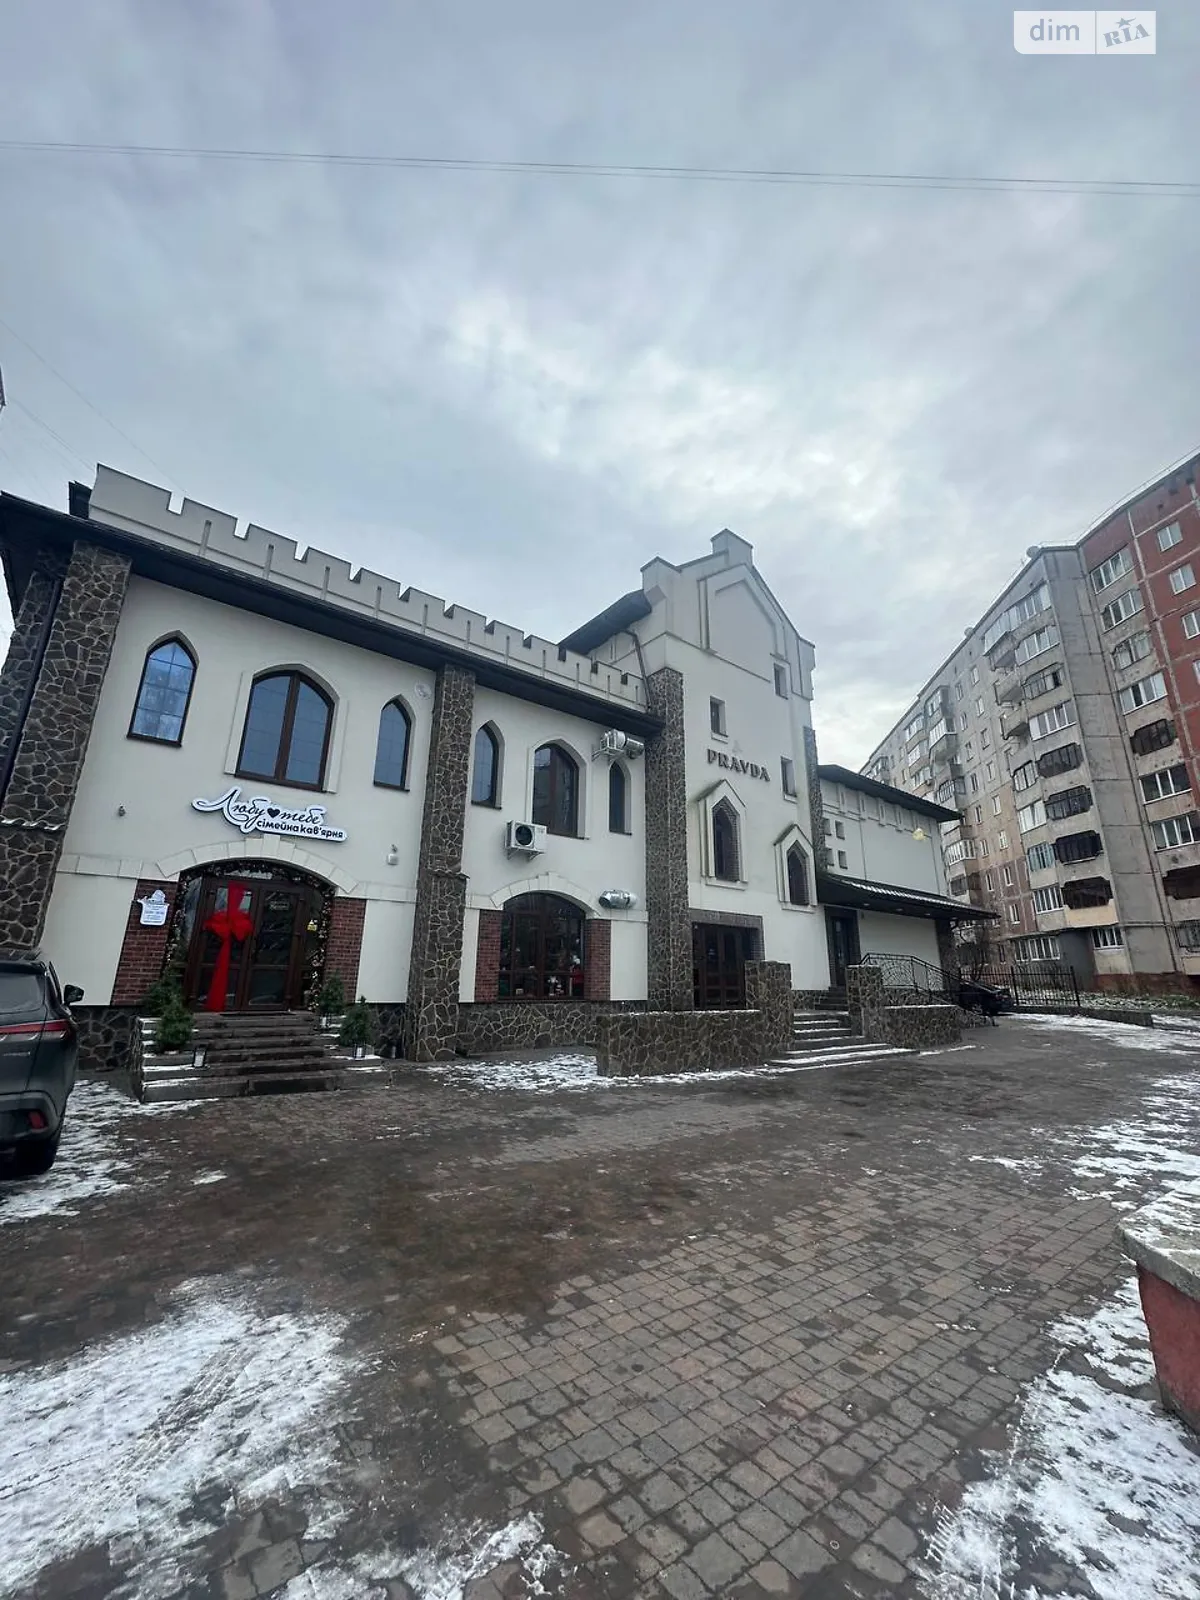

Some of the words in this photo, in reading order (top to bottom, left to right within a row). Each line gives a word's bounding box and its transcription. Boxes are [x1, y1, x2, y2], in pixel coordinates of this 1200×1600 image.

[706, 748, 771, 782] PRAVDA
[256, 818, 299, 832] сімейна
[279, 808, 325, 825] тебе
